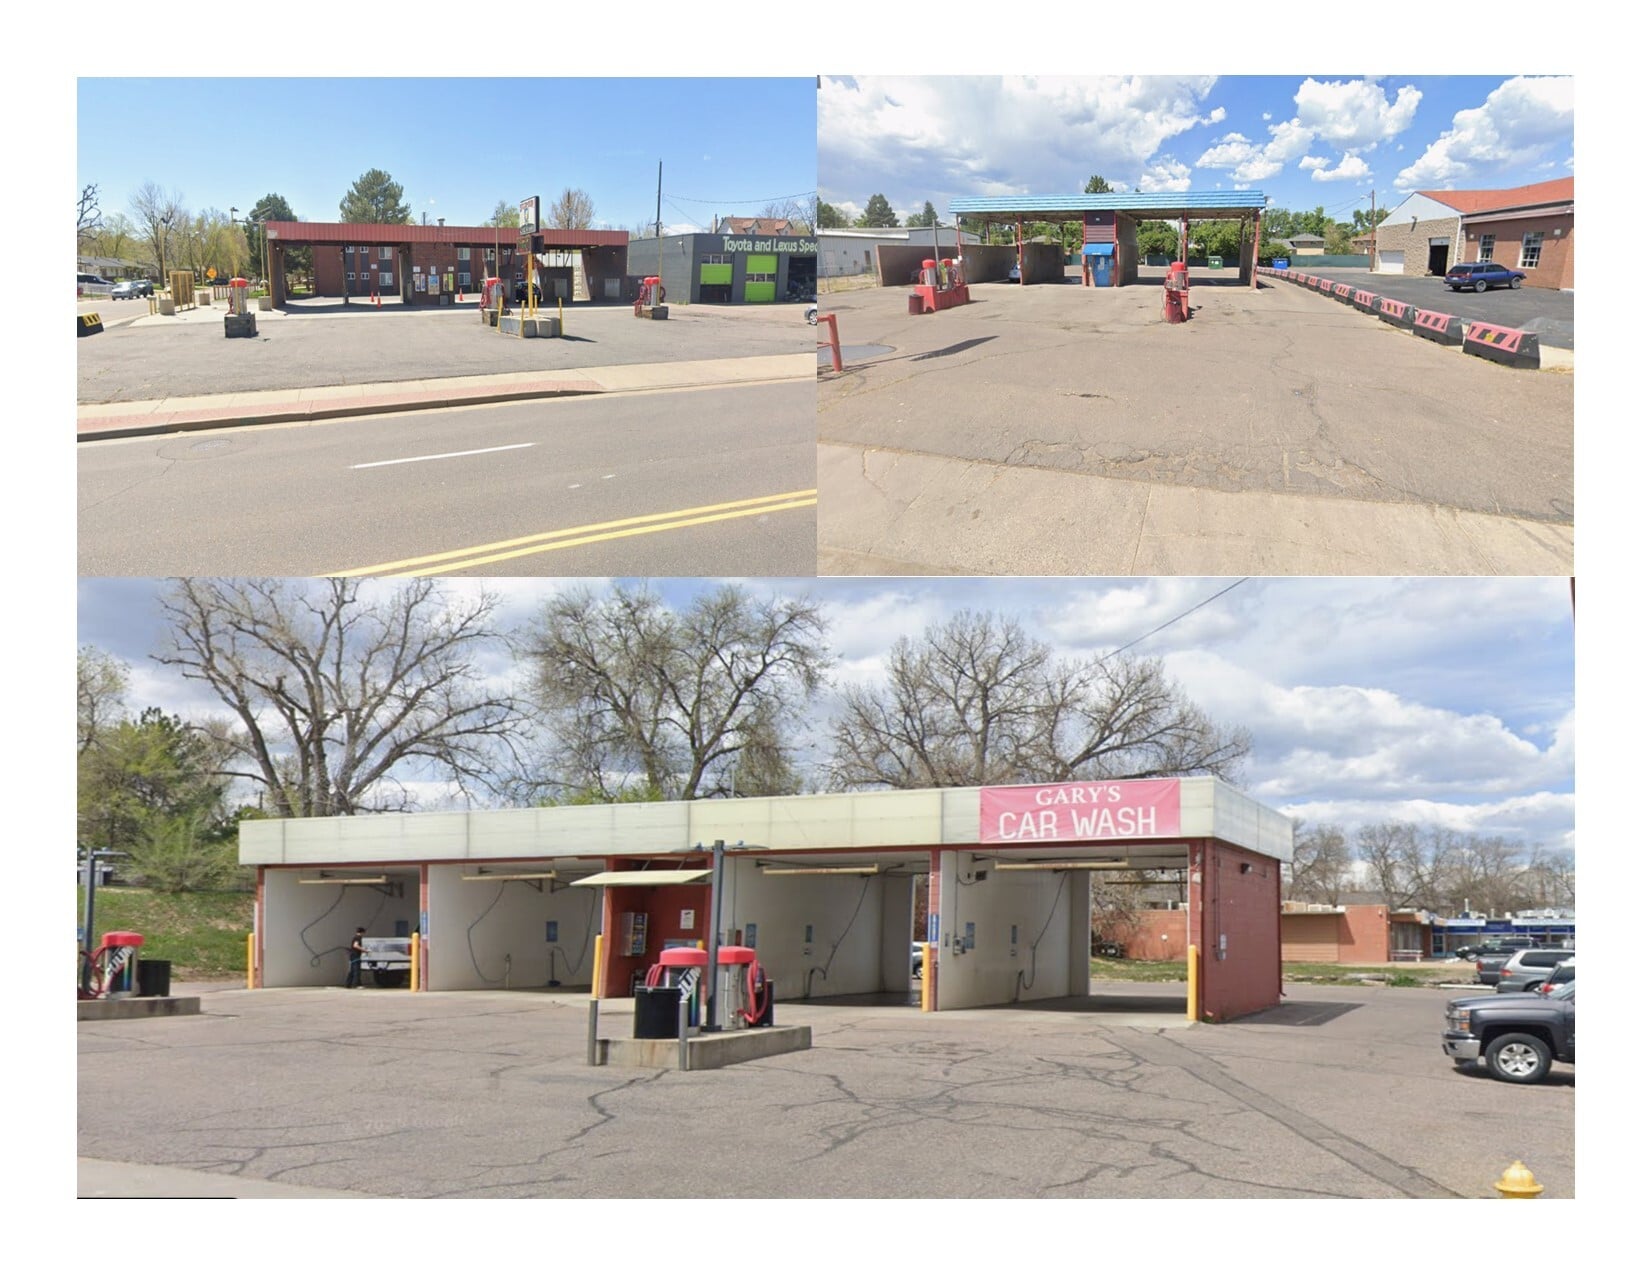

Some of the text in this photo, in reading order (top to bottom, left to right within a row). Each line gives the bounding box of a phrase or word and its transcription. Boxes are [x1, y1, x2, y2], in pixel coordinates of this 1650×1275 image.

[722, 235, 752, 252] Toyota
[754, 239, 772, 252] and
[773, 238, 798, 252] Lexus
[1036, 785, 1121, 805] GARY'S
[999, 806, 1156, 840] CAR WASH
